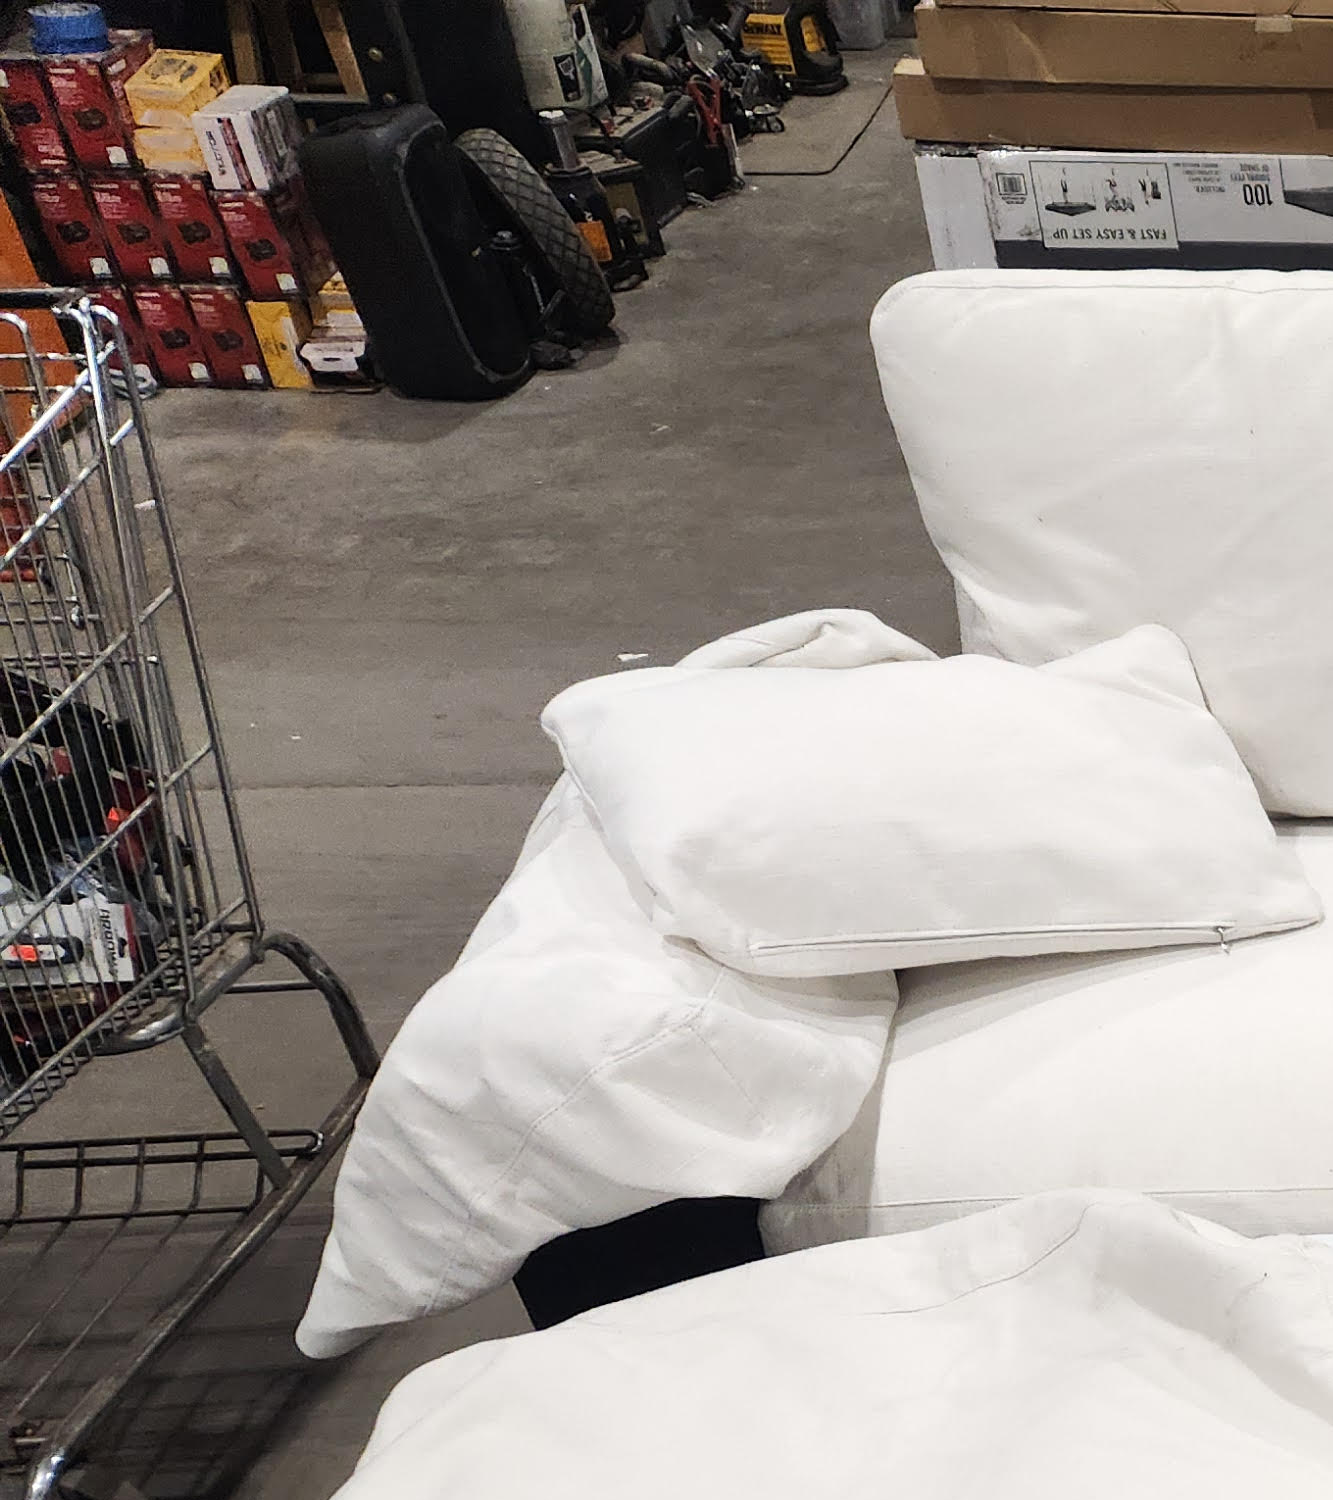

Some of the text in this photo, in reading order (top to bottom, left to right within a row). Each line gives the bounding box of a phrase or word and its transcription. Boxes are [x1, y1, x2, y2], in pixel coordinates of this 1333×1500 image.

[1243, 184, 1273, 206] 100
[1052, 228, 1167, 240] FAST & EASY SET UP
